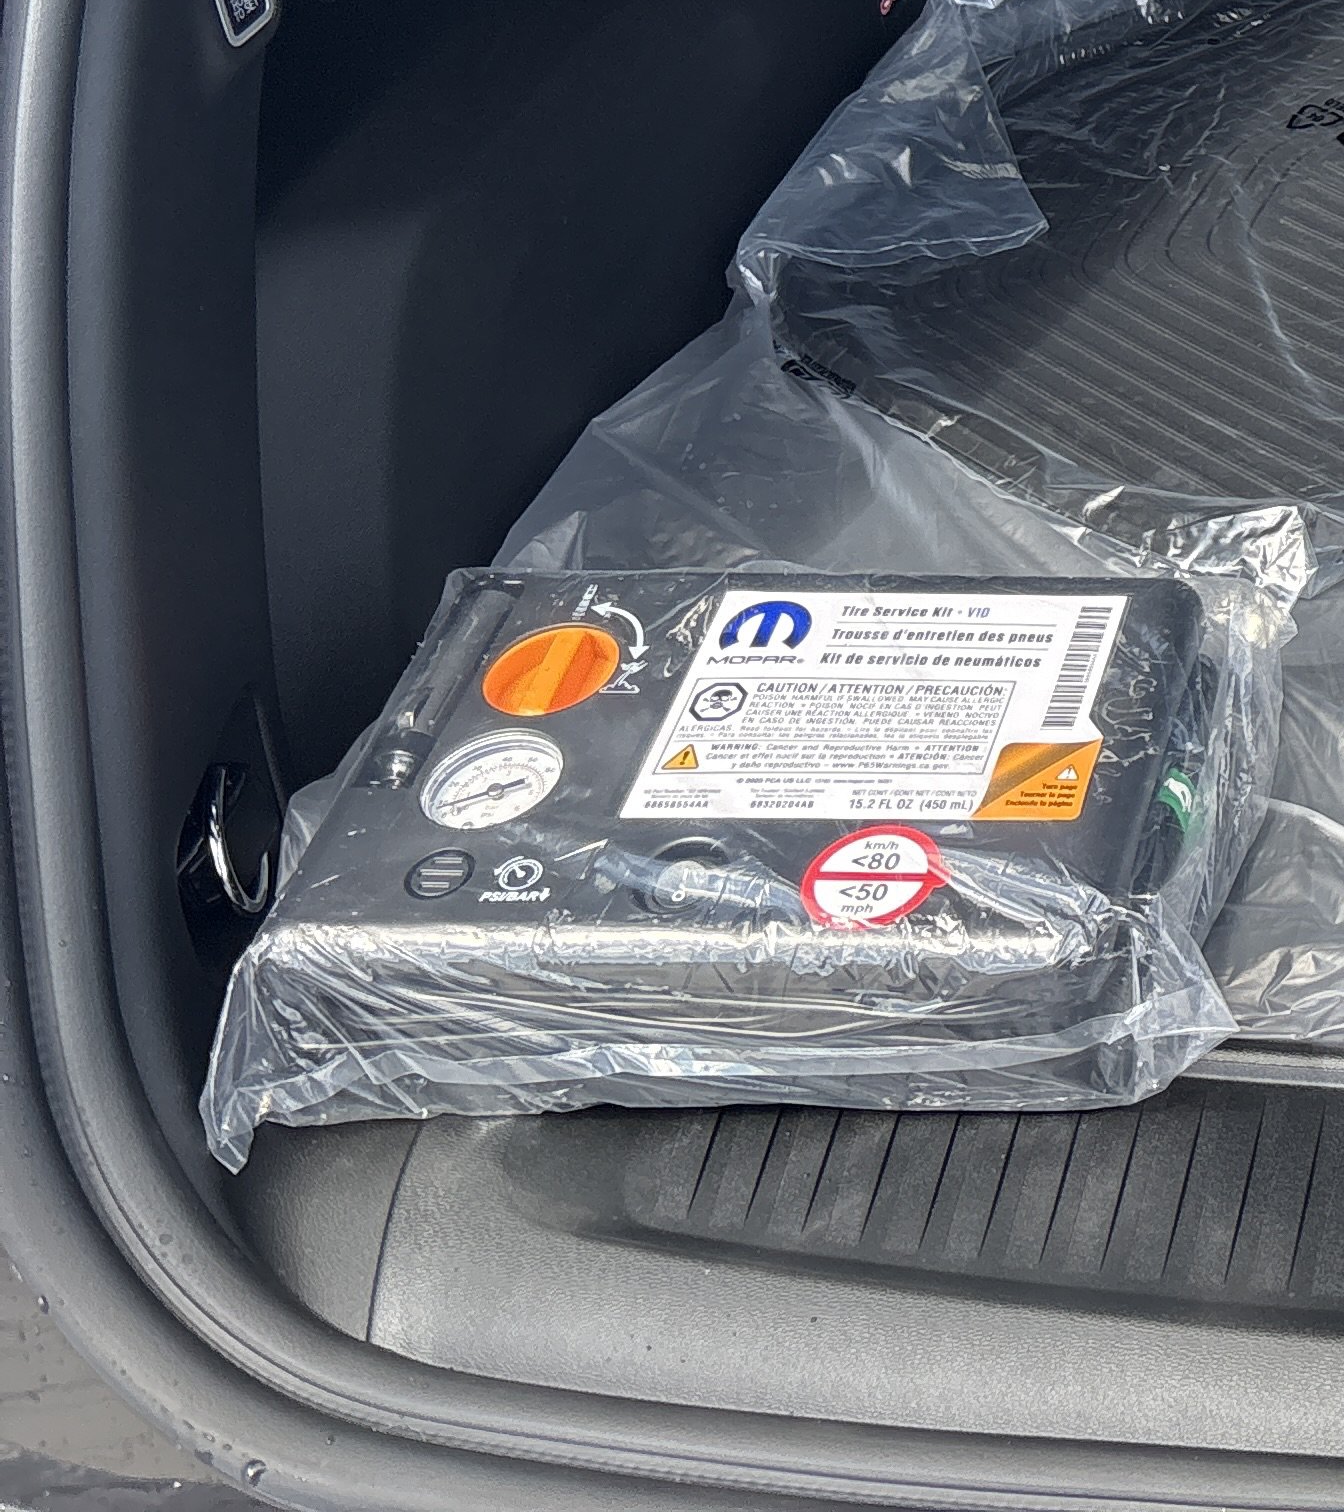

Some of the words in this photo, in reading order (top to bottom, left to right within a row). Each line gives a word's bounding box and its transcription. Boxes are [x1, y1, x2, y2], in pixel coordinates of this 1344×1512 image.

[841, 605, 870, 617] Tire
[872, 606, 929, 618] Service
[931, 606, 954, 618] Kit
[831, 628, 890, 640] Trousse
[892, 628, 975, 642] d'entretien
[978, 630, 1005, 642] des
[1007, 632, 1054, 645] pneus
[819, 652, 842, 664] Kit
[844, 652, 864, 665] de
[866, 652, 929, 665] servicio
[931, 653, 951, 666] de
[953, 655, 1042, 668] neumáticos
[756, 682, 818, 693] CAUTION
[828, 683, 905, 695] ATTENTION
[766, 743, 799, 751] Cancer
[823, 744, 882, 752] Reproductive
[829, 753, 886, 761] reproduction
[764, 761, 821, 769] reproductivo
[849, 798, 876, 809] 15.2
[878, 799, 892, 809] FL
[896, 799, 914, 809] OZ
[919, 799, 948, 811] (450
[949, 799, 974, 811] mL)
[864, 840, 899, 850] km/h
[851, 852, 901, 871] <80
[478, 891, 539, 902] PSI/BAR
[839, 883, 889, 901] <50
[840, 903, 874, 915] mph
